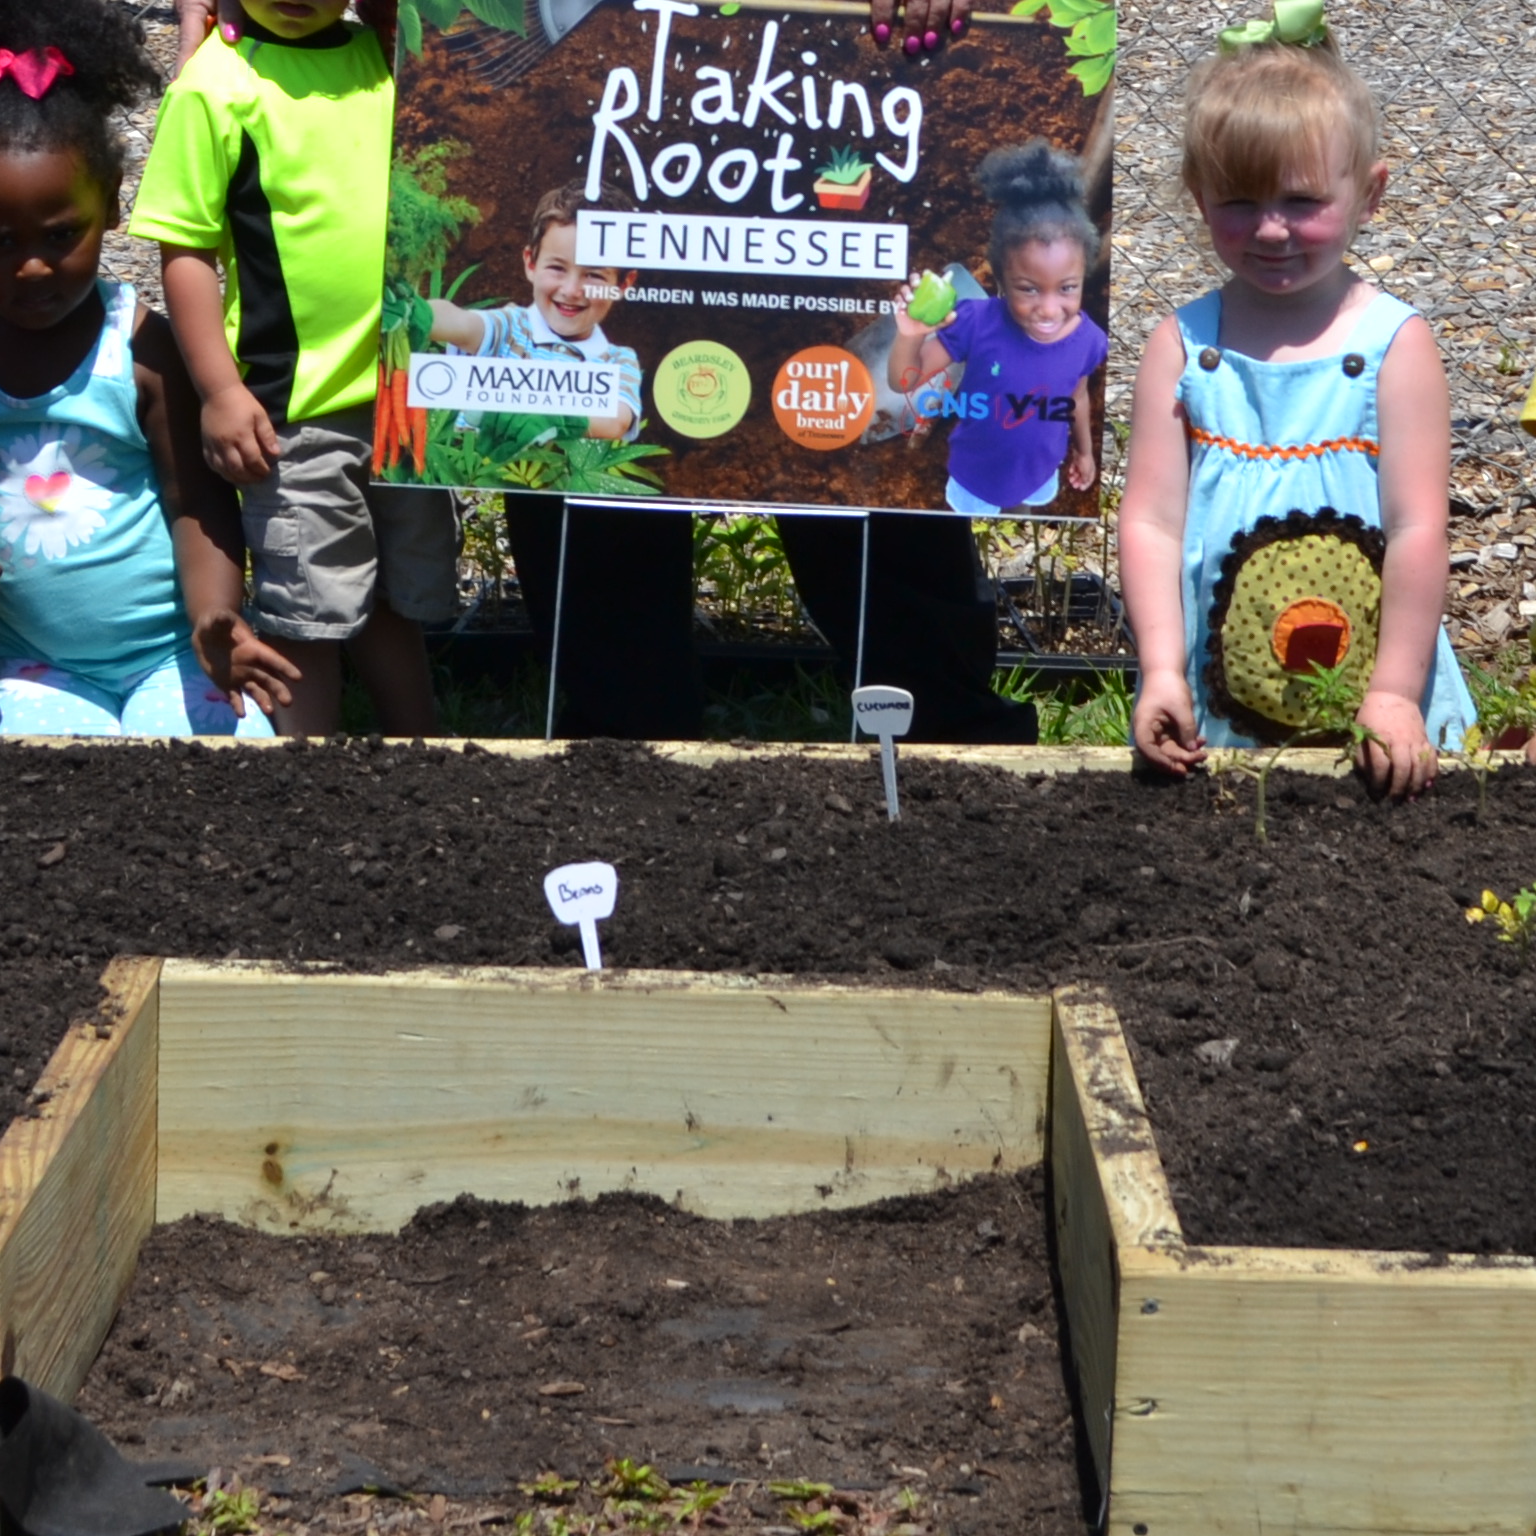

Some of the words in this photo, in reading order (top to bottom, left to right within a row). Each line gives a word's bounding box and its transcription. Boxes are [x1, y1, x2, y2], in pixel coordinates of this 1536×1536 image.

[584, 67, 805, 213] Root
[590, 220, 895, 270] TENNESSEE
[583, 284, 621, 300] THIS
[624, 287, 695, 305] GARDEN
[700, 291, 739, 307] WAS
[742, 293, 791, 310] MADE
[794, 296, 875, 313] POSSIBLE
[467, 365, 611, 395] MAXIMUS
[786, 360, 839, 379] our
[466, 390, 609, 409] FOUNDATION
[777, 361, 871, 420] daily
[916, 389, 990, 420] CNS
[796, 412, 846, 430] bread
[557, 882, 604, 903] Beans
